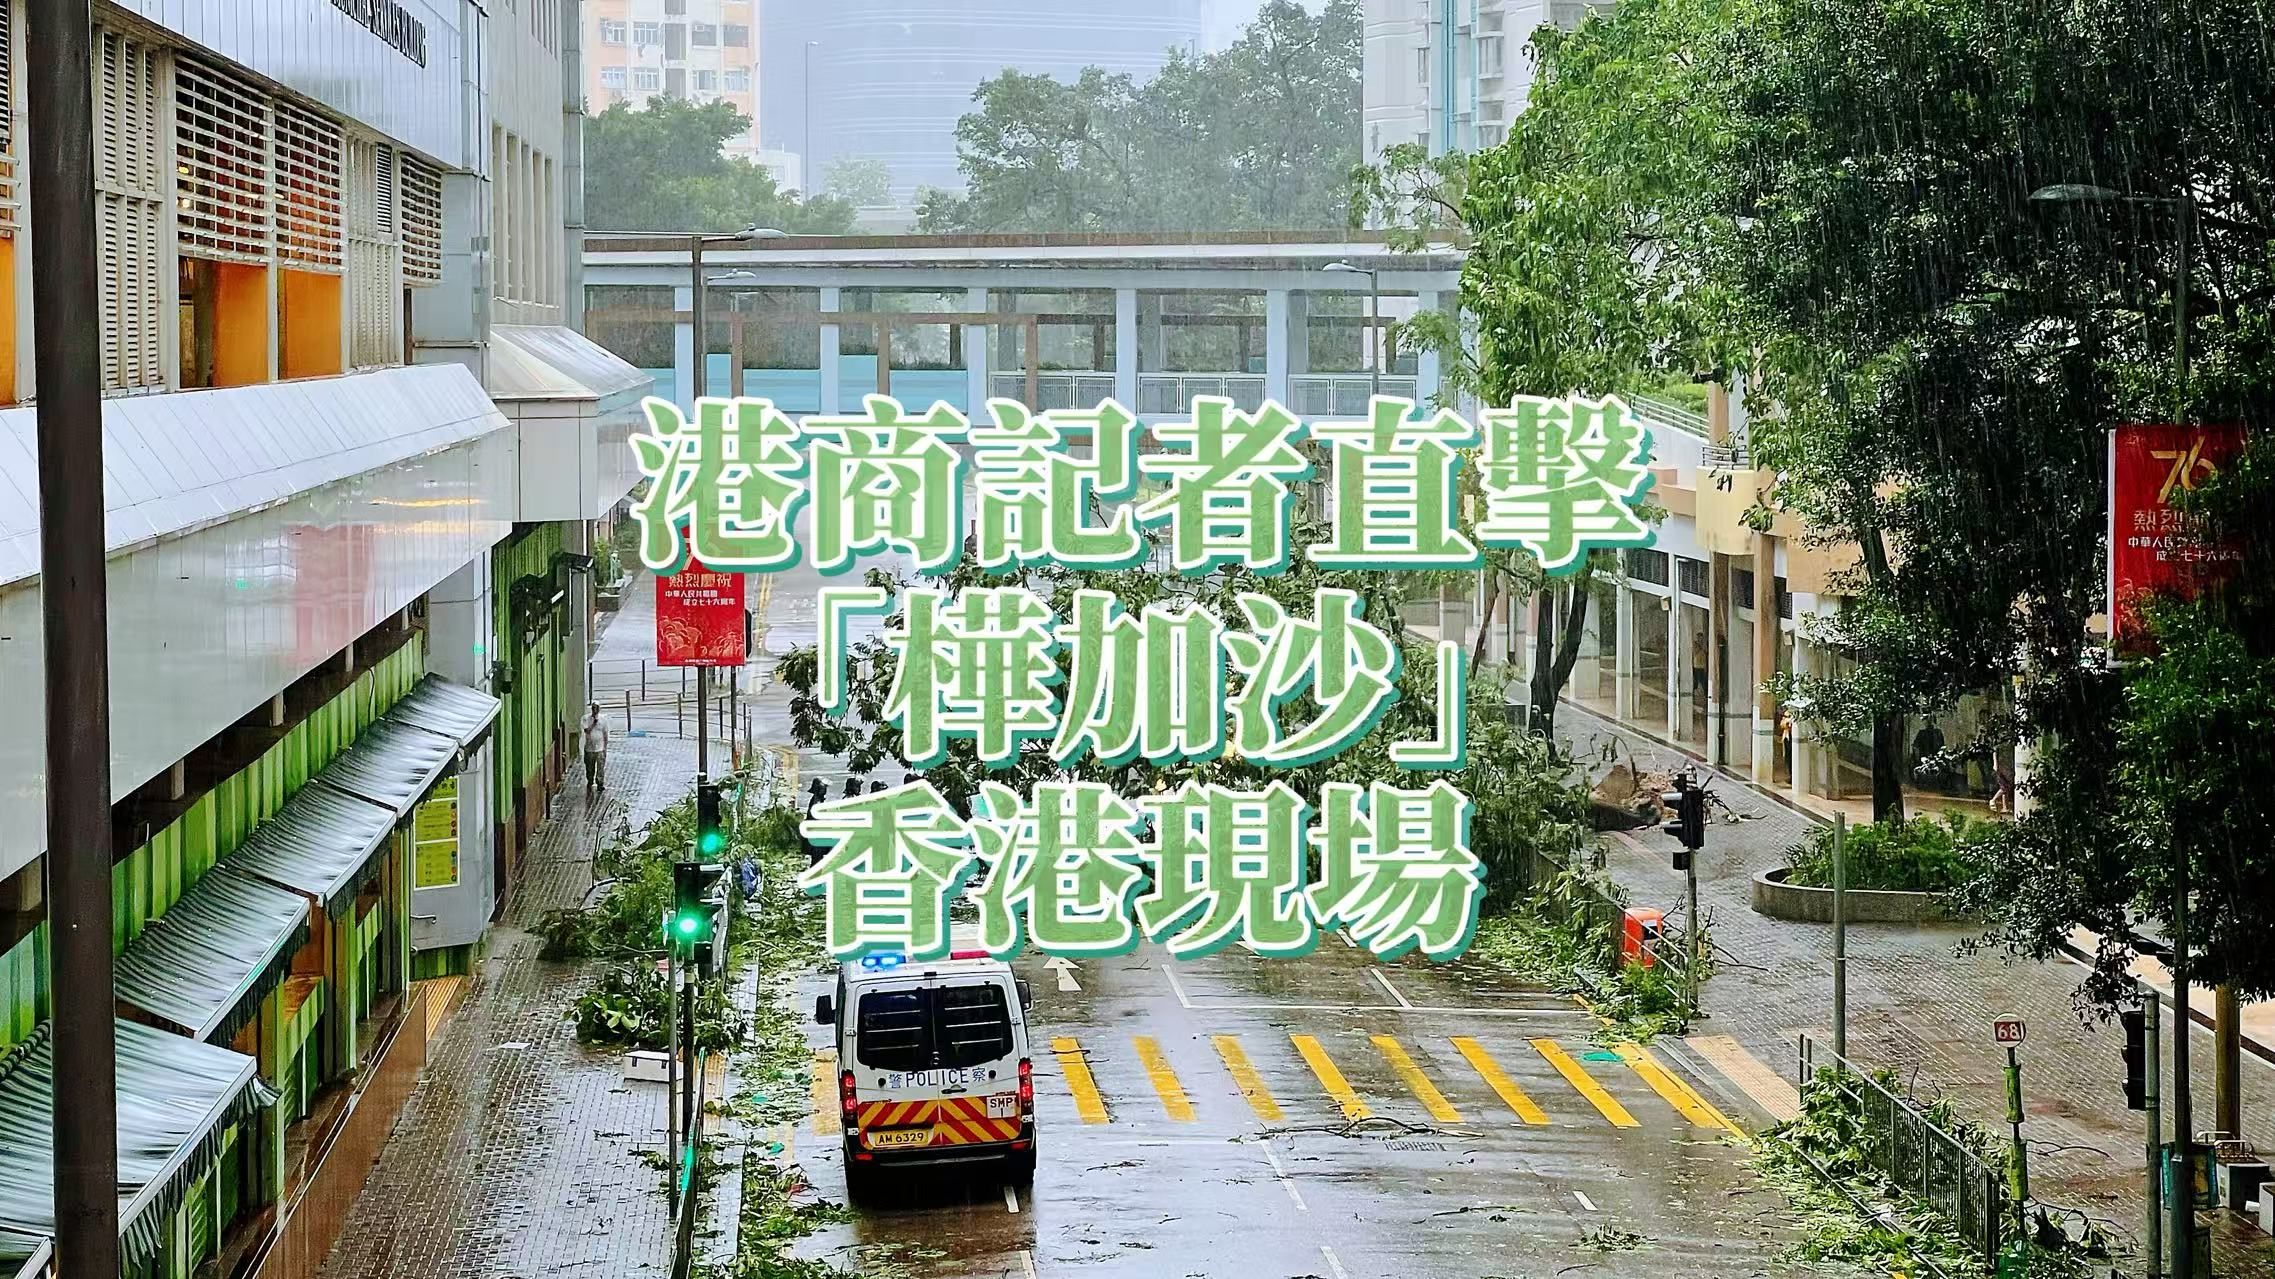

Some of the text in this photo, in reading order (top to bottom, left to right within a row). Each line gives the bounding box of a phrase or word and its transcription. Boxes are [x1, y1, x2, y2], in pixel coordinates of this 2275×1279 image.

[1997, 1023, 2021, 1040] 68
[905, 1068, 969, 1087] POLICE
[989, 1096, 1014, 1108] SMP
[878, 1132, 924, 1144] AM 6329
